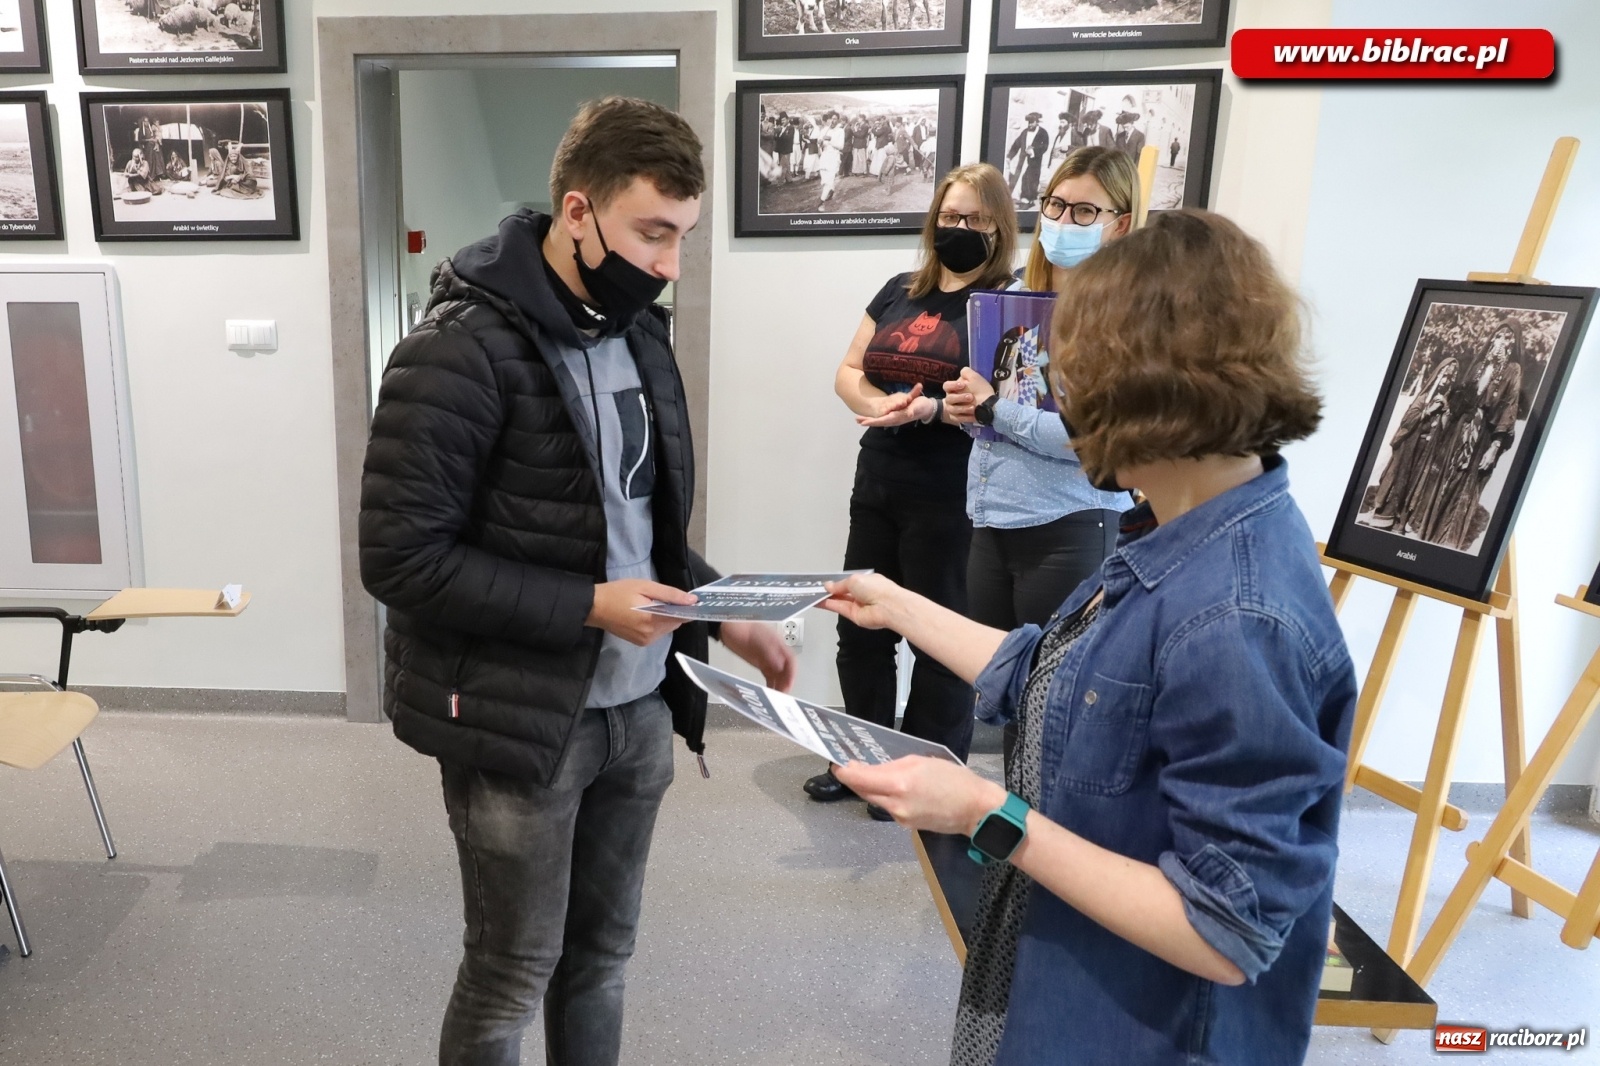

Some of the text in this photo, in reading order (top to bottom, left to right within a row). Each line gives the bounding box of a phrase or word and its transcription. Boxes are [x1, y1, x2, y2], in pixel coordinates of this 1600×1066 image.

[1072, 31, 1080, 39] W
[1079, 31, 1107, 39] namiocie
[845, 37, 860, 45] Orka
[129, 56, 148, 64] Pasterz
[149, 56, 168, 64] arabski
[179, 55, 204, 63] Jeziorem
[205, 55, 234, 64] Galilejskim
[790, 218, 812, 226] Ludowa
[840, 217, 867, 225] arabskich
[868, 216, 901, 225] chrześcijan
[1396, 549, 1418, 561] Arabki
